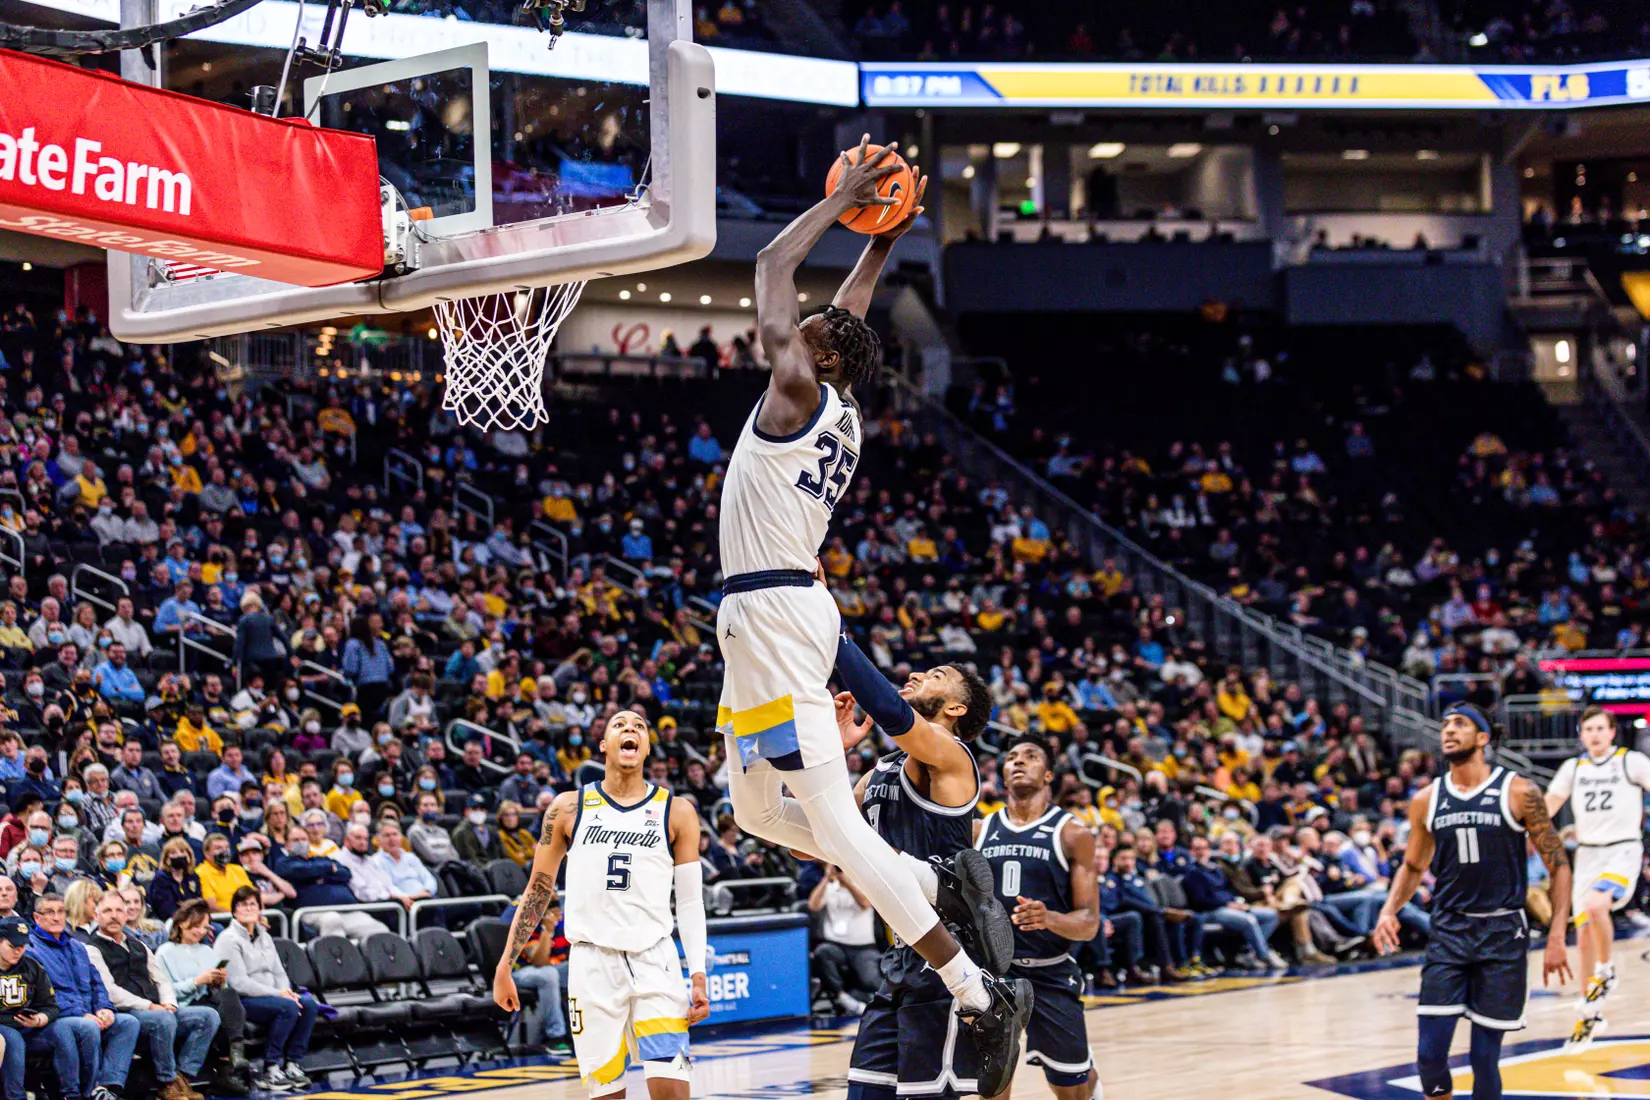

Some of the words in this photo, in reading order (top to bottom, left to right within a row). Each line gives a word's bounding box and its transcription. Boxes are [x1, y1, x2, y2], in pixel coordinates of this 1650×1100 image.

[1128, 73, 1183, 94] TOTAL
[794, 431, 858, 512] 35
[1585, 790, 1613, 811] 22
[1435, 811, 1502, 830] GEORGETOWN
[582, 825, 661, 849] Marquette
[1455, 827, 1480, 864] 11
[982, 844, 1051, 861] GEORGETOWN
[606, 852, 632, 891] 5
[1002, 860, 1021, 897] 0
